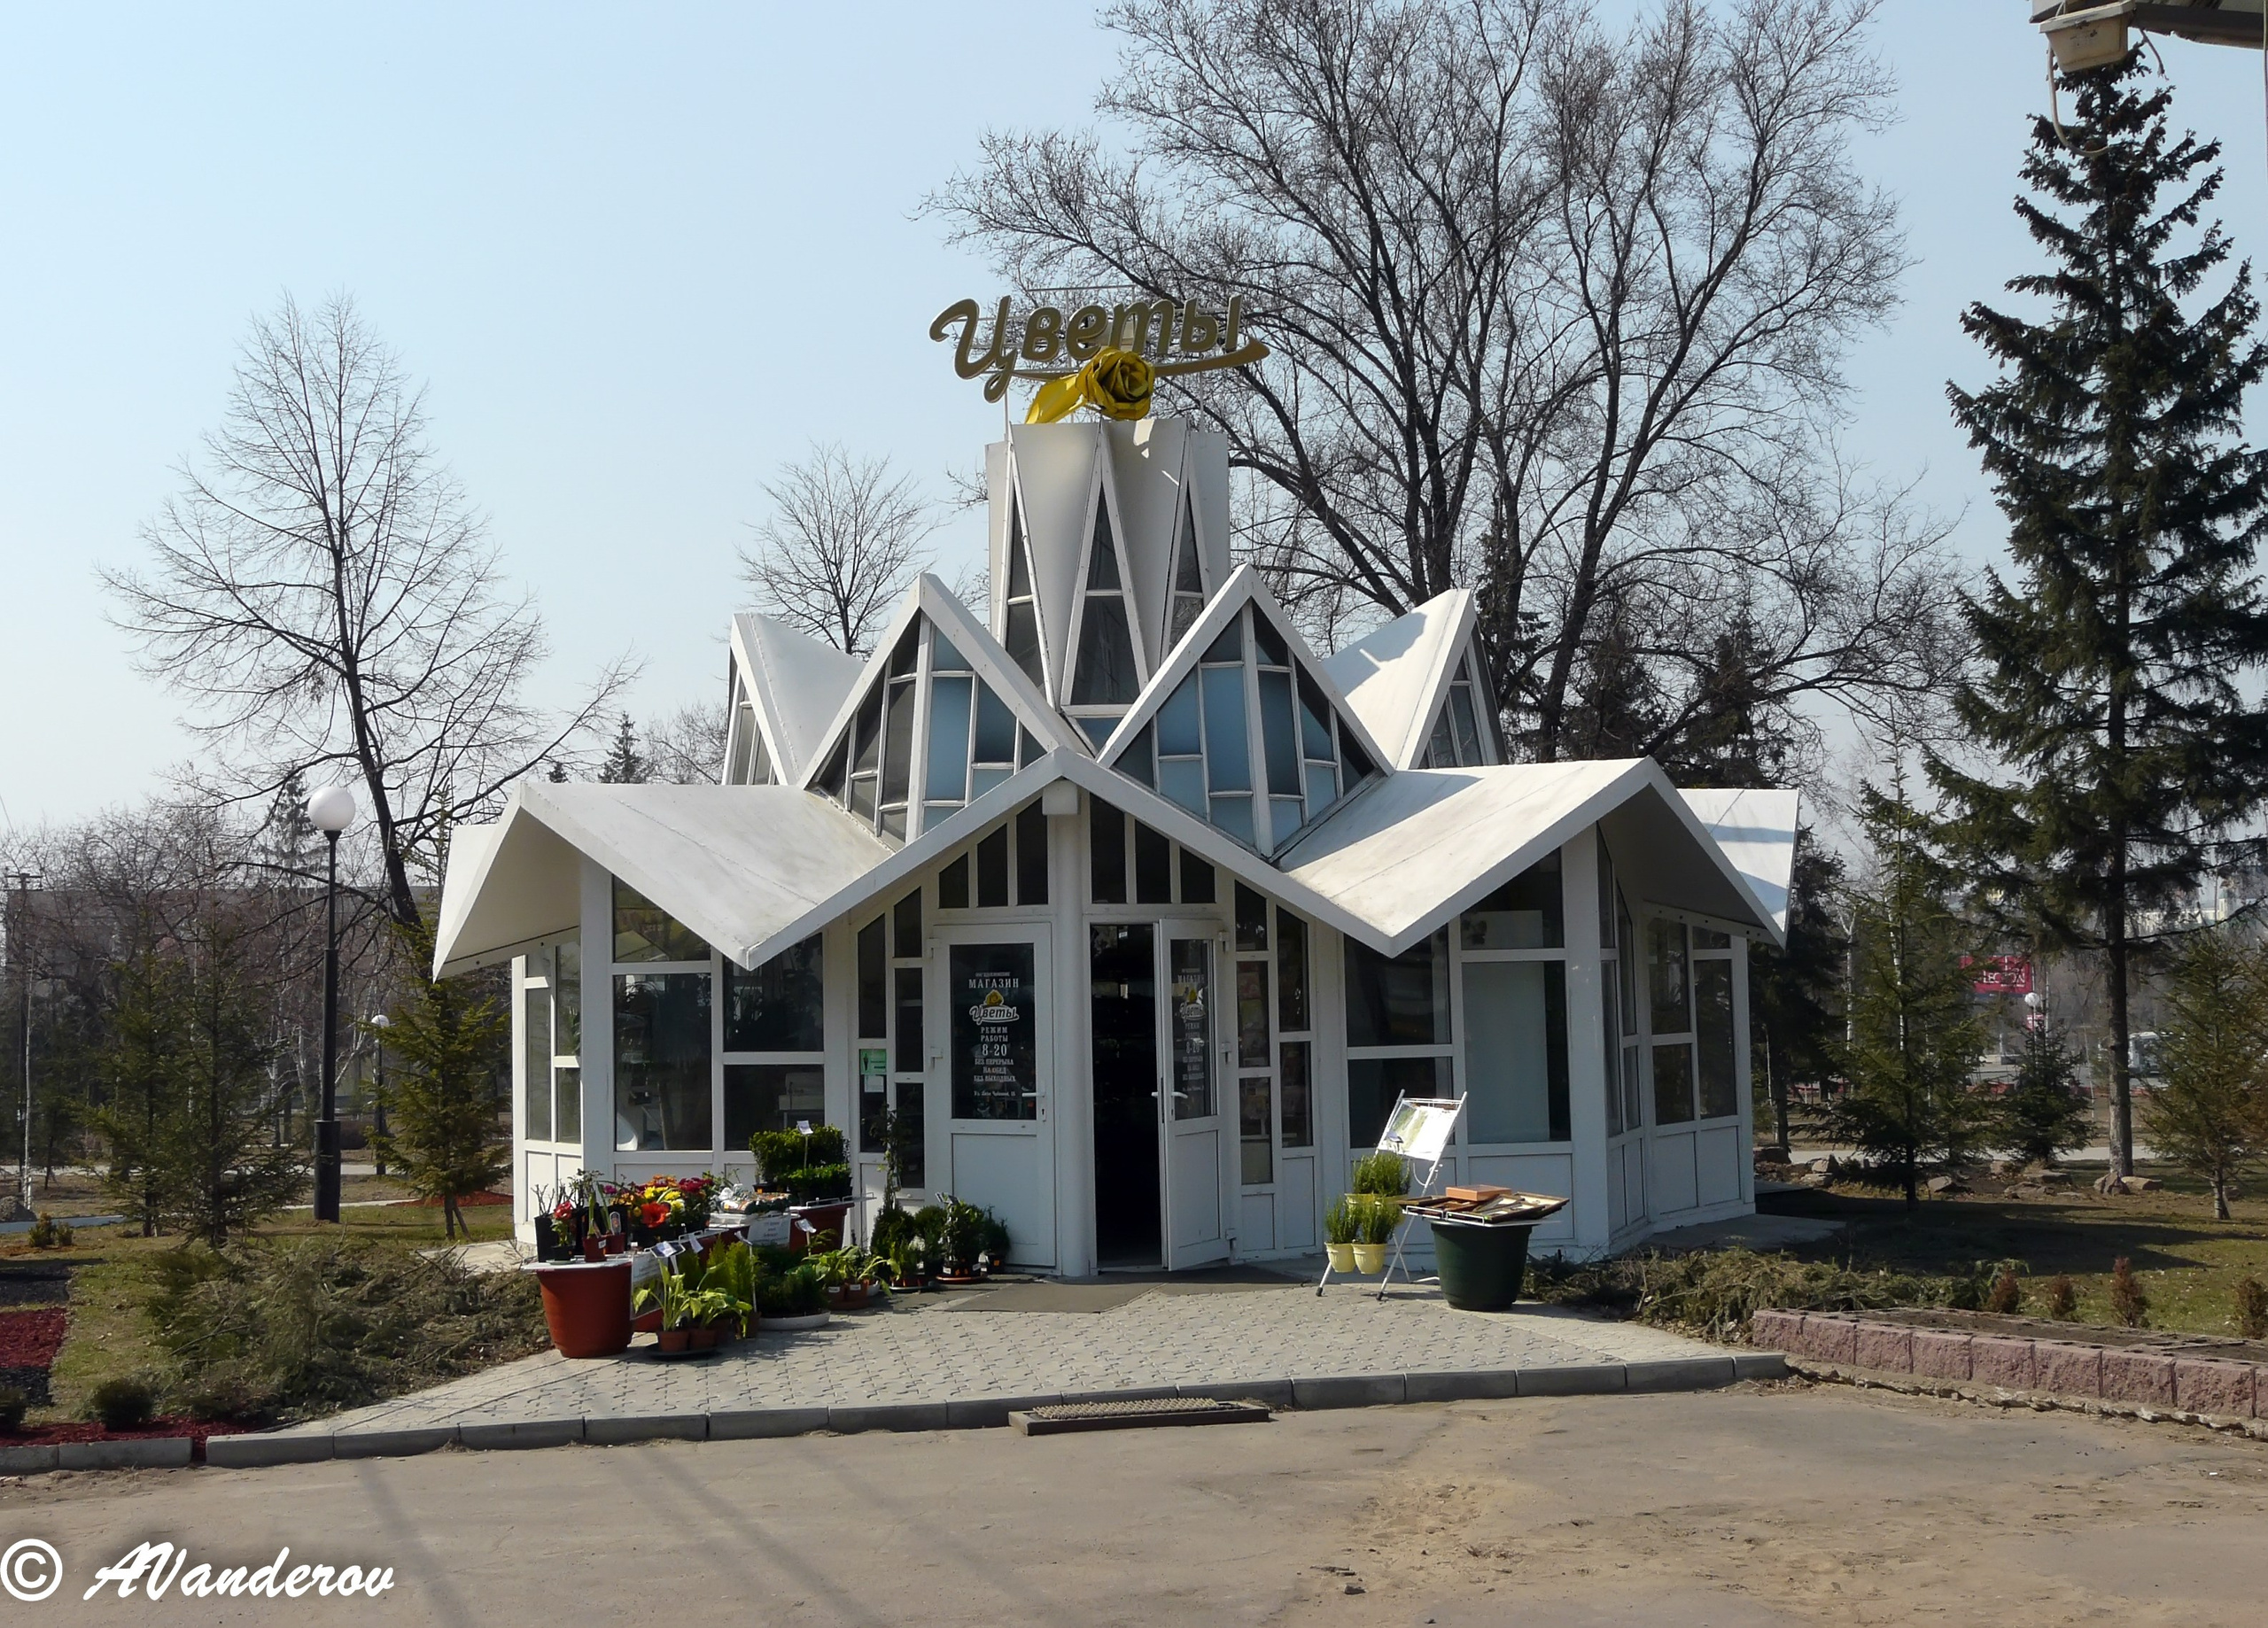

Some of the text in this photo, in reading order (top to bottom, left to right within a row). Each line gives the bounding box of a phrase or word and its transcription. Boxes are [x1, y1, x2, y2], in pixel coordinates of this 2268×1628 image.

[928, 295, 1242, 404] Цветы
[968, 978, 1019, 988] МАГАЗИН
[969, 1005, 1020, 1025] Цветы
[983, 1043, 1006, 1056] 8-20
